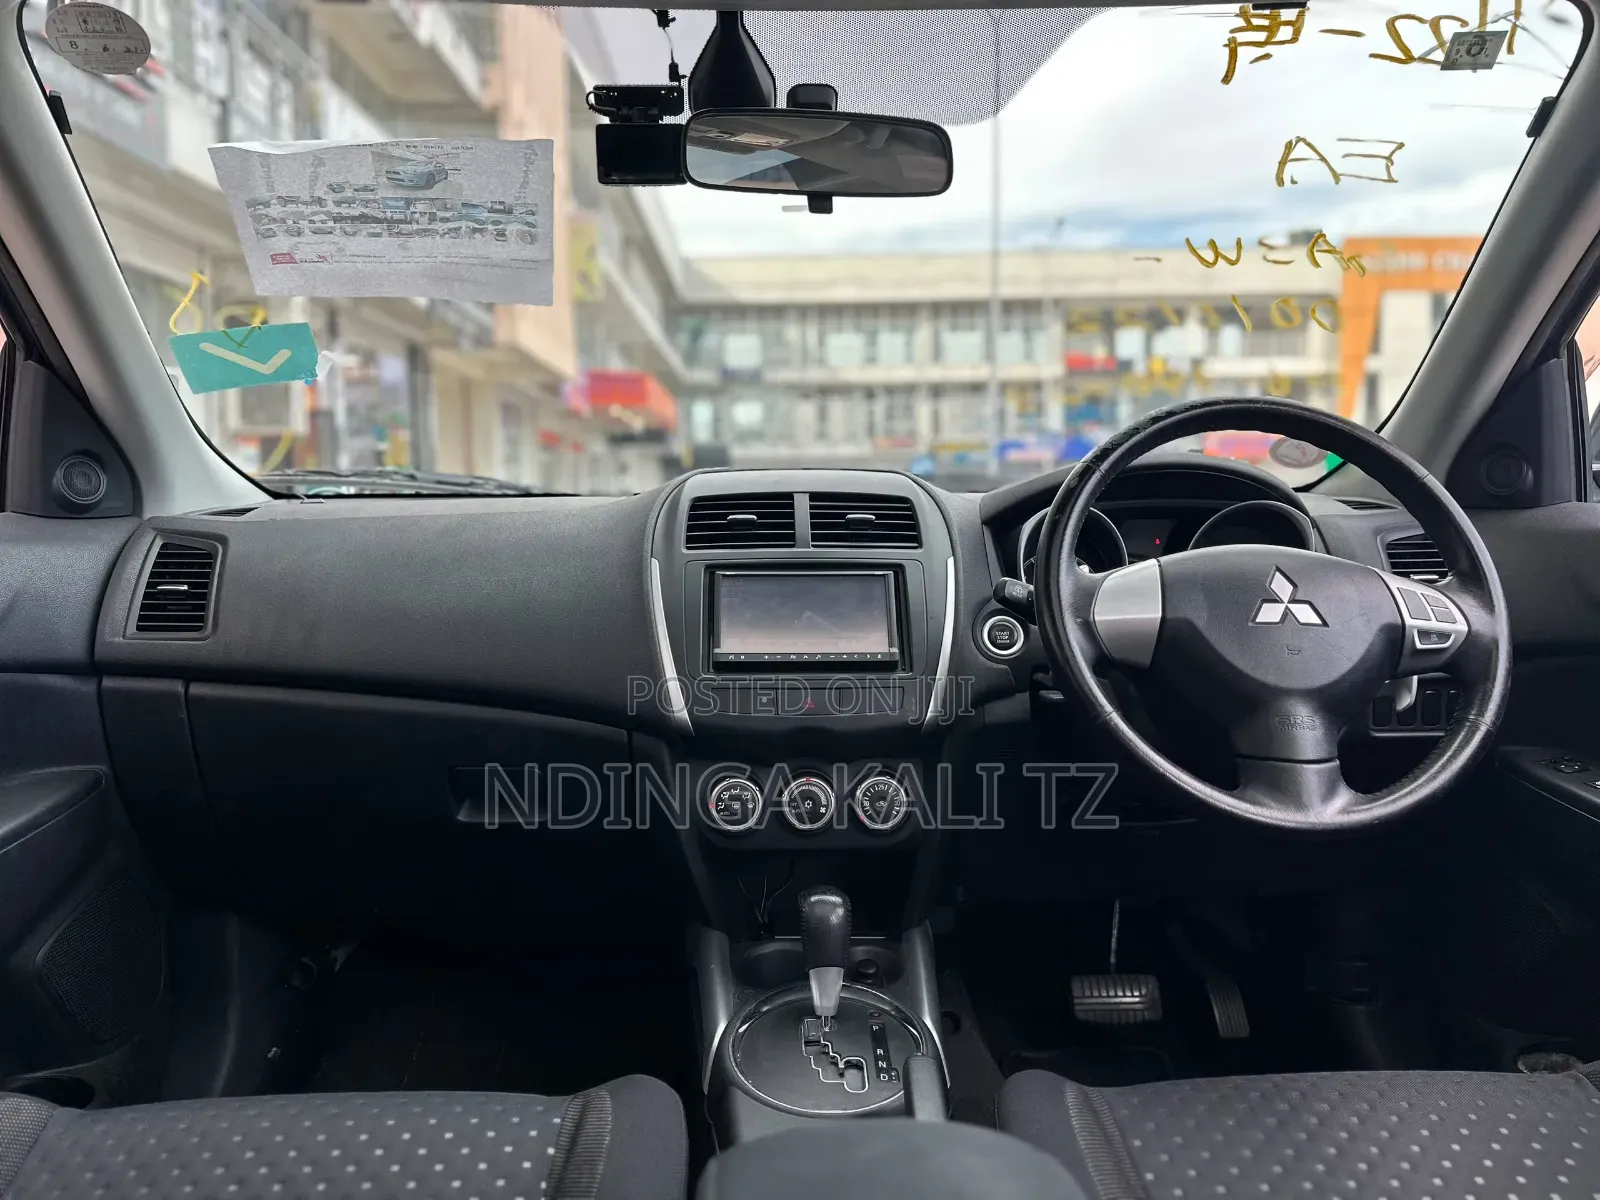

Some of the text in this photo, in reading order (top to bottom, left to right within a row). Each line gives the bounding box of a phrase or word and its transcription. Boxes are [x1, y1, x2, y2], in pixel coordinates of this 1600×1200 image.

[876, 1048, 884, 1056] R
[878, 1060, 887, 1068] N
[880, 1073, 889, 1081] D
